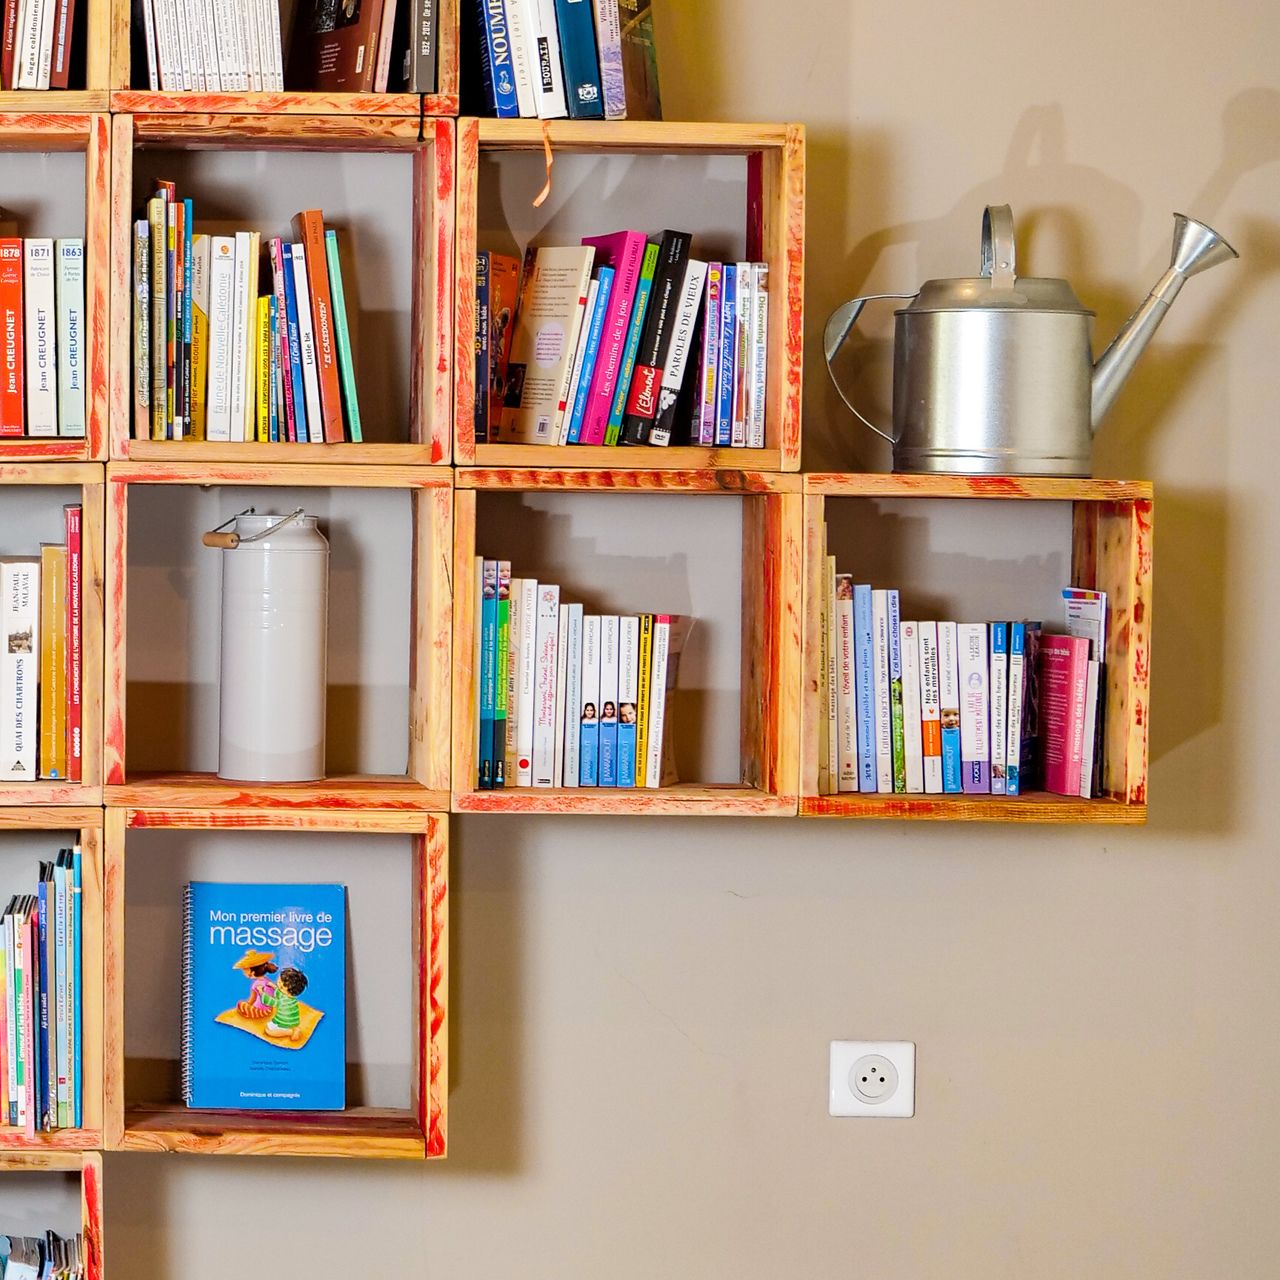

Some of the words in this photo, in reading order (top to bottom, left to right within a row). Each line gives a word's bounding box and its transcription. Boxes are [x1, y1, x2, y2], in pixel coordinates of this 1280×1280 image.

[27, 52, 37, 76] Sagas
[540, 42, 552, 84] BOURAIL
[0, 248, 20, 257] 1878
[31, 248, 50, 256] 1871
[62, 248, 82, 256] 1863
[685, 275, 700, 308] VIEUX
[616, 299, 628, 316] joie
[682, 310, 691, 326] DE
[615, 318, 624, 327] la
[756, 296, 766, 344] Discovering
[6, 309, 15, 370] CREUGNET
[38, 308, 47, 369] CREUGNET
[69, 308, 78, 367] CREUGNET
[613, 329, 622, 340] de
[304, 344, 313, 365] Little
[604, 343, 620, 379] chemins
[669, 329, 687, 377] PAROLES
[755, 346, 766, 384] Baby-led
[7, 372, 17, 393] Jean
[39, 371, 48, 392] Jean
[71, 370, 79, 390] Jean
[215, 371, 225, 383] de
[601, 382, 610, 396] Les
[754, 385, 764, 423] Weaning
[12, 571, 20, 612] JEAN-PAUL
[21, 571, 30, 607] MALAVAL
[841, 614, 849, 639] enfant
[842, 661, 849, 670] de
[14, 658, 24, 710] CHARTRONS
[924, 689, 932, 704] Nos
[15, 712, 24, 728] DES
[14, 730, 24, 752] QUAI
[210, 911, 237, 922] Mon
[240, 911, 285, 924] premier
[289, 911, 313, 922] livre
[317, 912, 332, 922] de
[210, 926, 332, 952] massage
